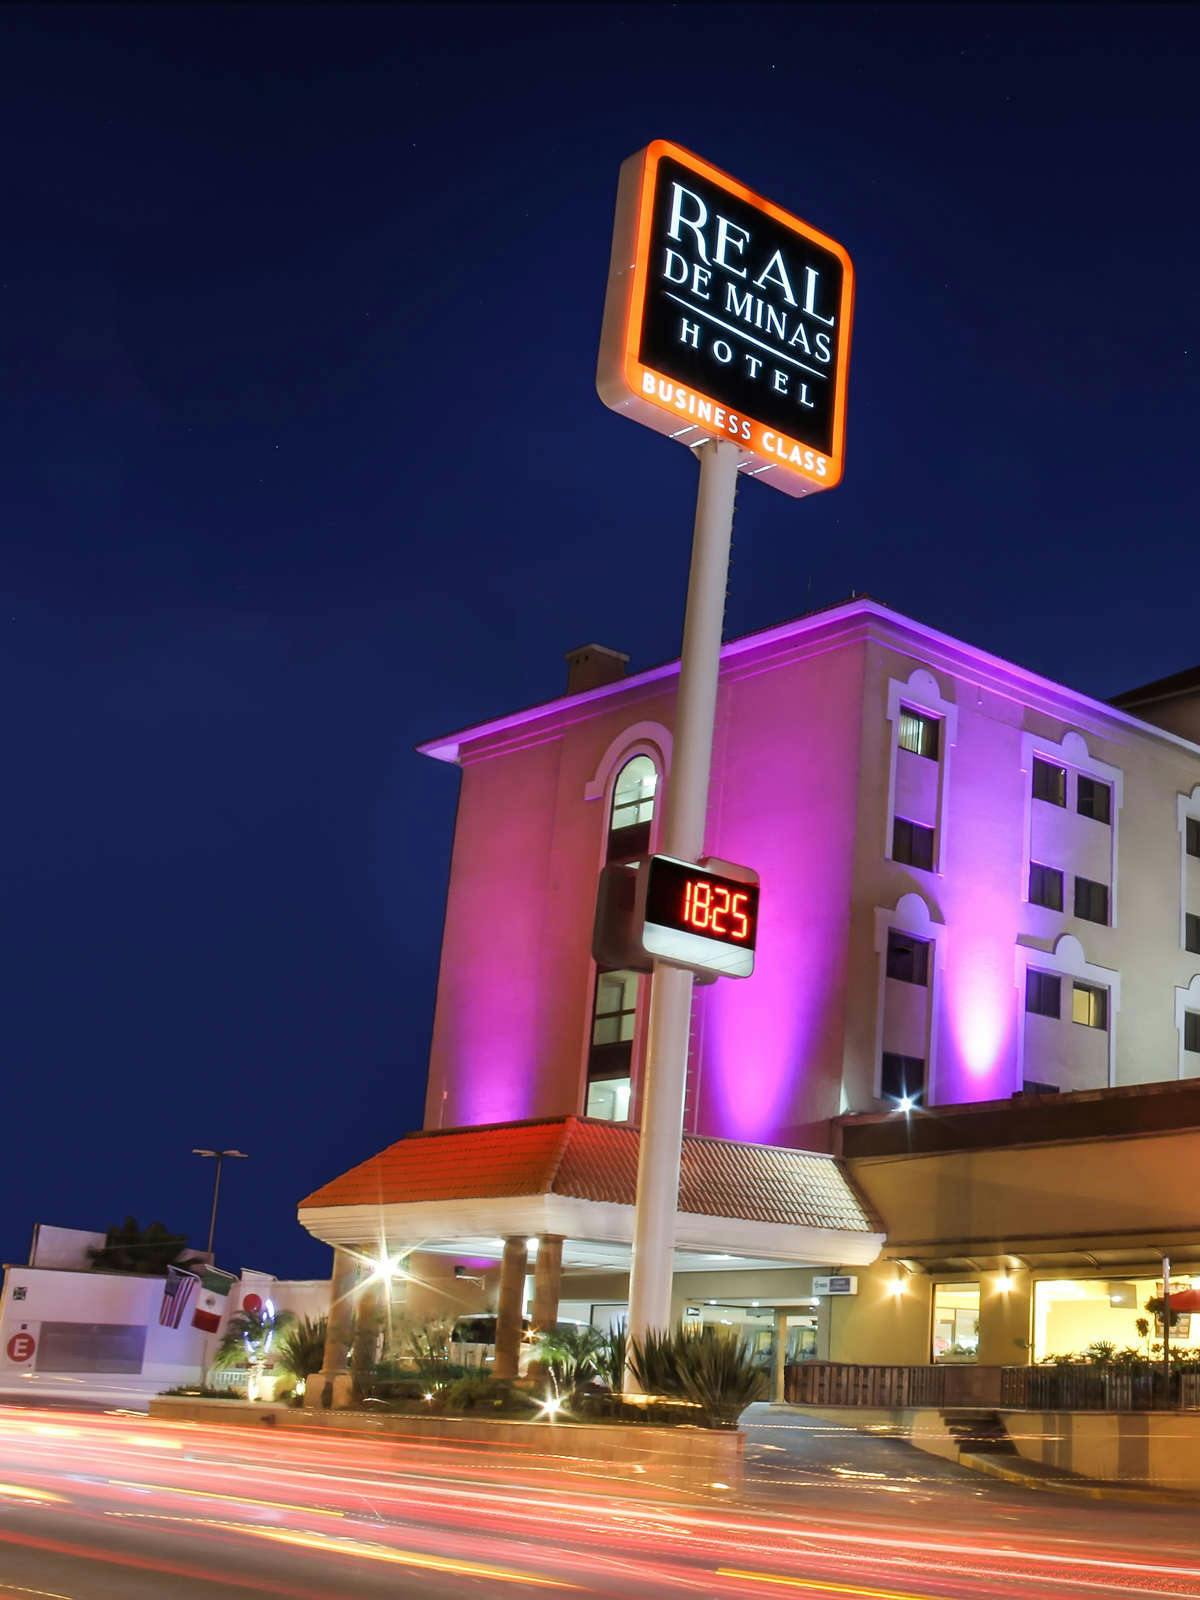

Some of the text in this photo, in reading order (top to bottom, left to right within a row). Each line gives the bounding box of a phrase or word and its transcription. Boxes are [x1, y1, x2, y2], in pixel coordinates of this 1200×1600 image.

[664, 248, 831, 363] DE MINAS
[667, 182, 834, 327] REAL
[681, 318, 814, 408] HOTEL
[642, 372, 828, 477] BUSINESS CLASS
[14, 1339, 28, 1357] E
